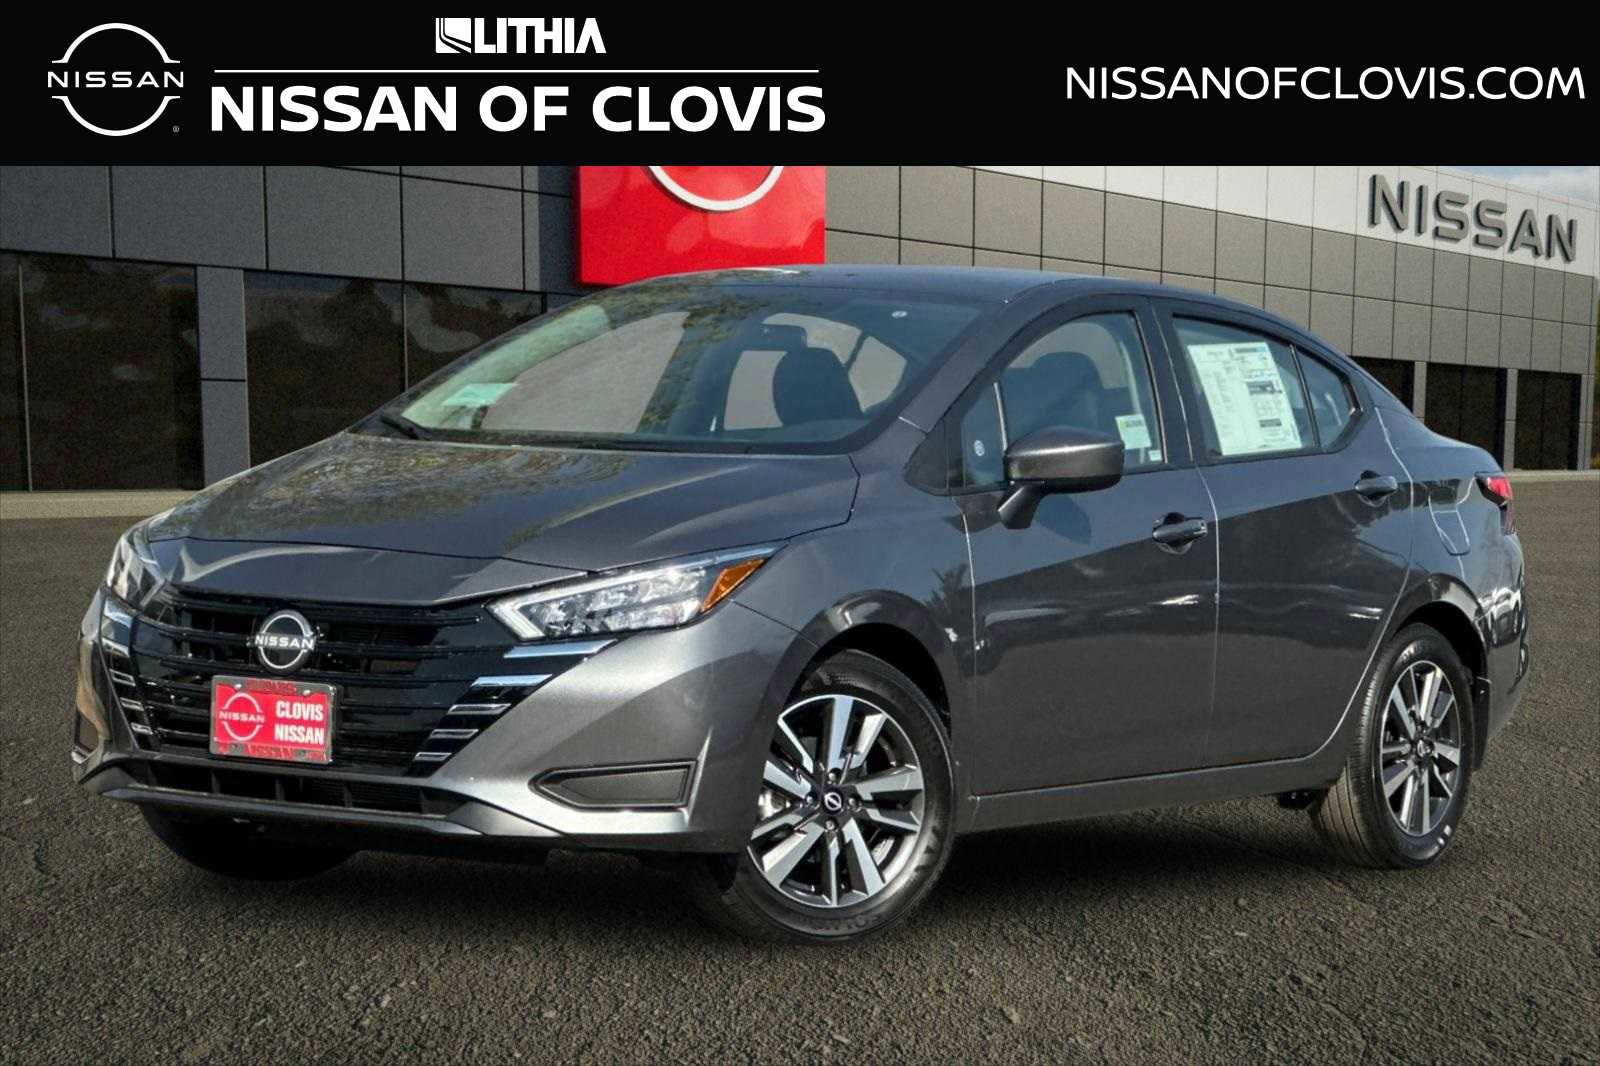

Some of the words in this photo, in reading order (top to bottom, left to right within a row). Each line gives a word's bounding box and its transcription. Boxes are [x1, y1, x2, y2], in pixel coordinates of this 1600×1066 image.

[1368, 174, 1578, 263] NISSAN
[255, 634, 315, 650] NISSAN
[219, 710, 264, 723] NISSAN
[276, 700, 324, 721] CLOVIS
[274, 723, 325, 745] NISSAN
